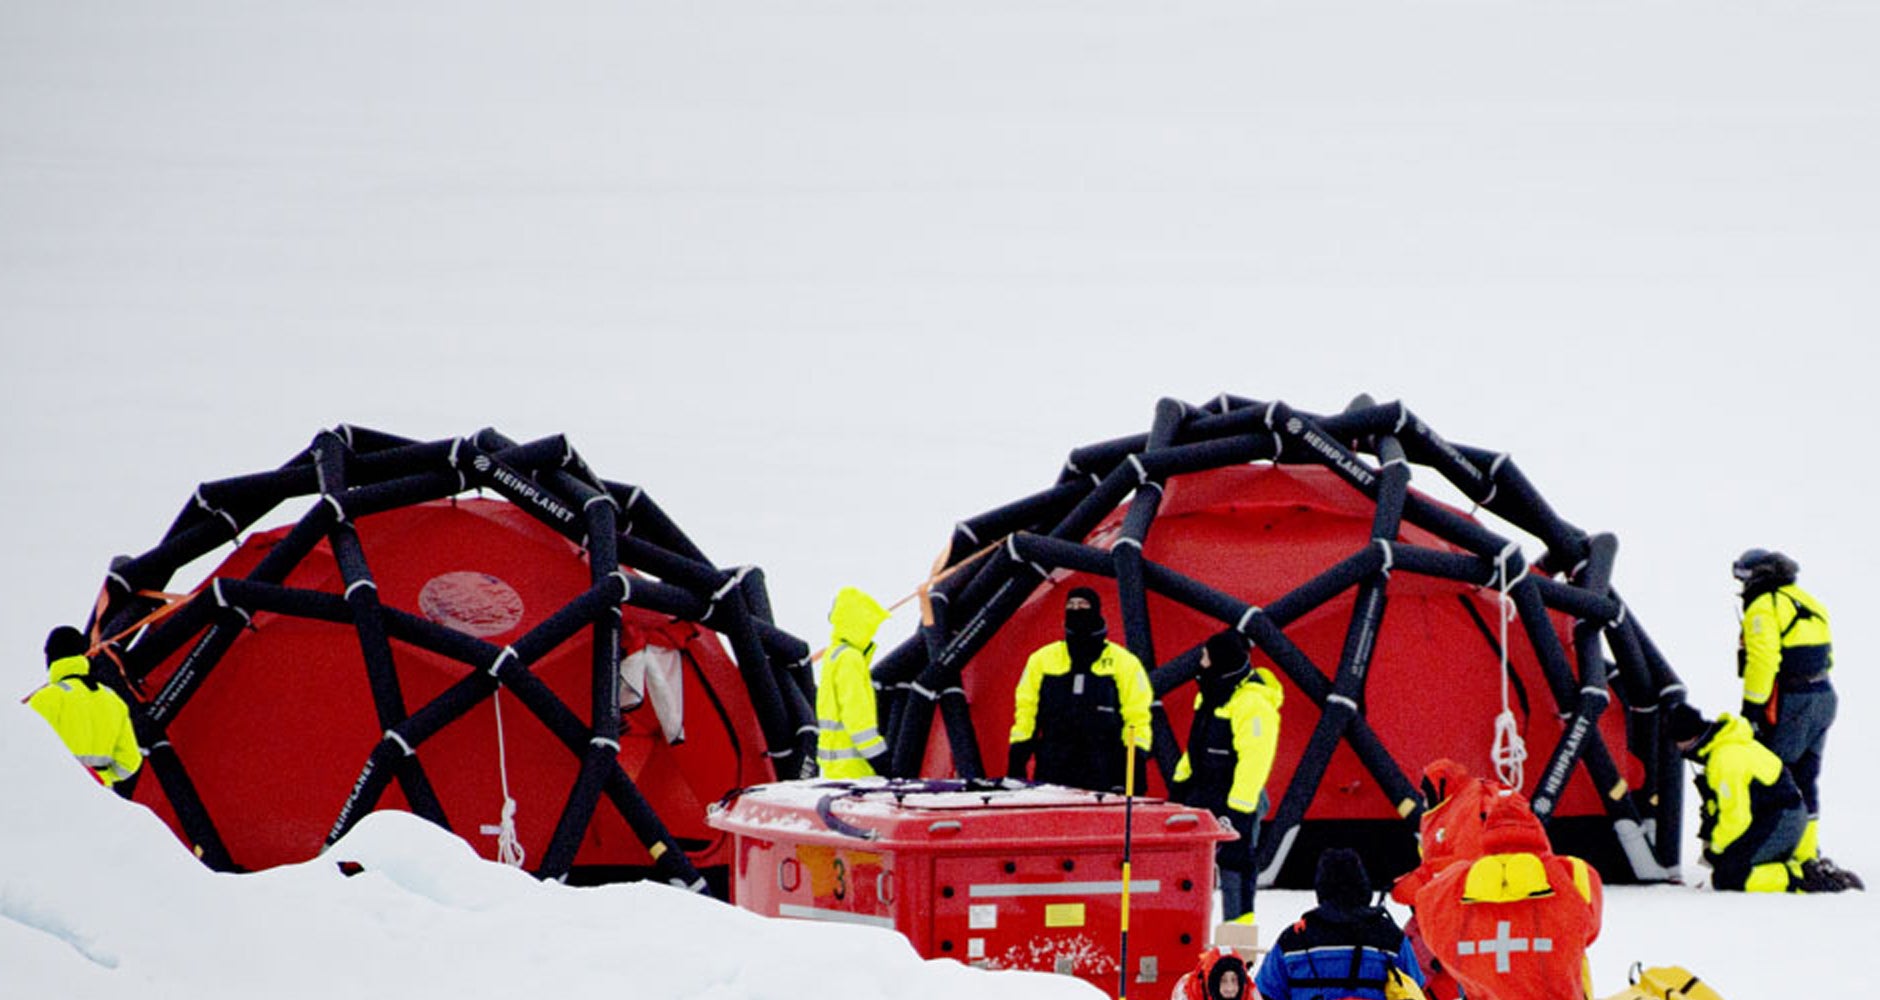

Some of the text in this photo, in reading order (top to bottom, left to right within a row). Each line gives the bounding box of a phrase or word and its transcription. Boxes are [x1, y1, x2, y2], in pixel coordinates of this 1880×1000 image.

[1303, 431, 1375, 485] HEIMPLANET
[493, 467, 575, 522] HEIMPLANET
[1545, 715, 1590, 795] HEIMPLANET
[329, 758, 375, 839] HEIMPLANET
[832, 857, 846, 901] 3
